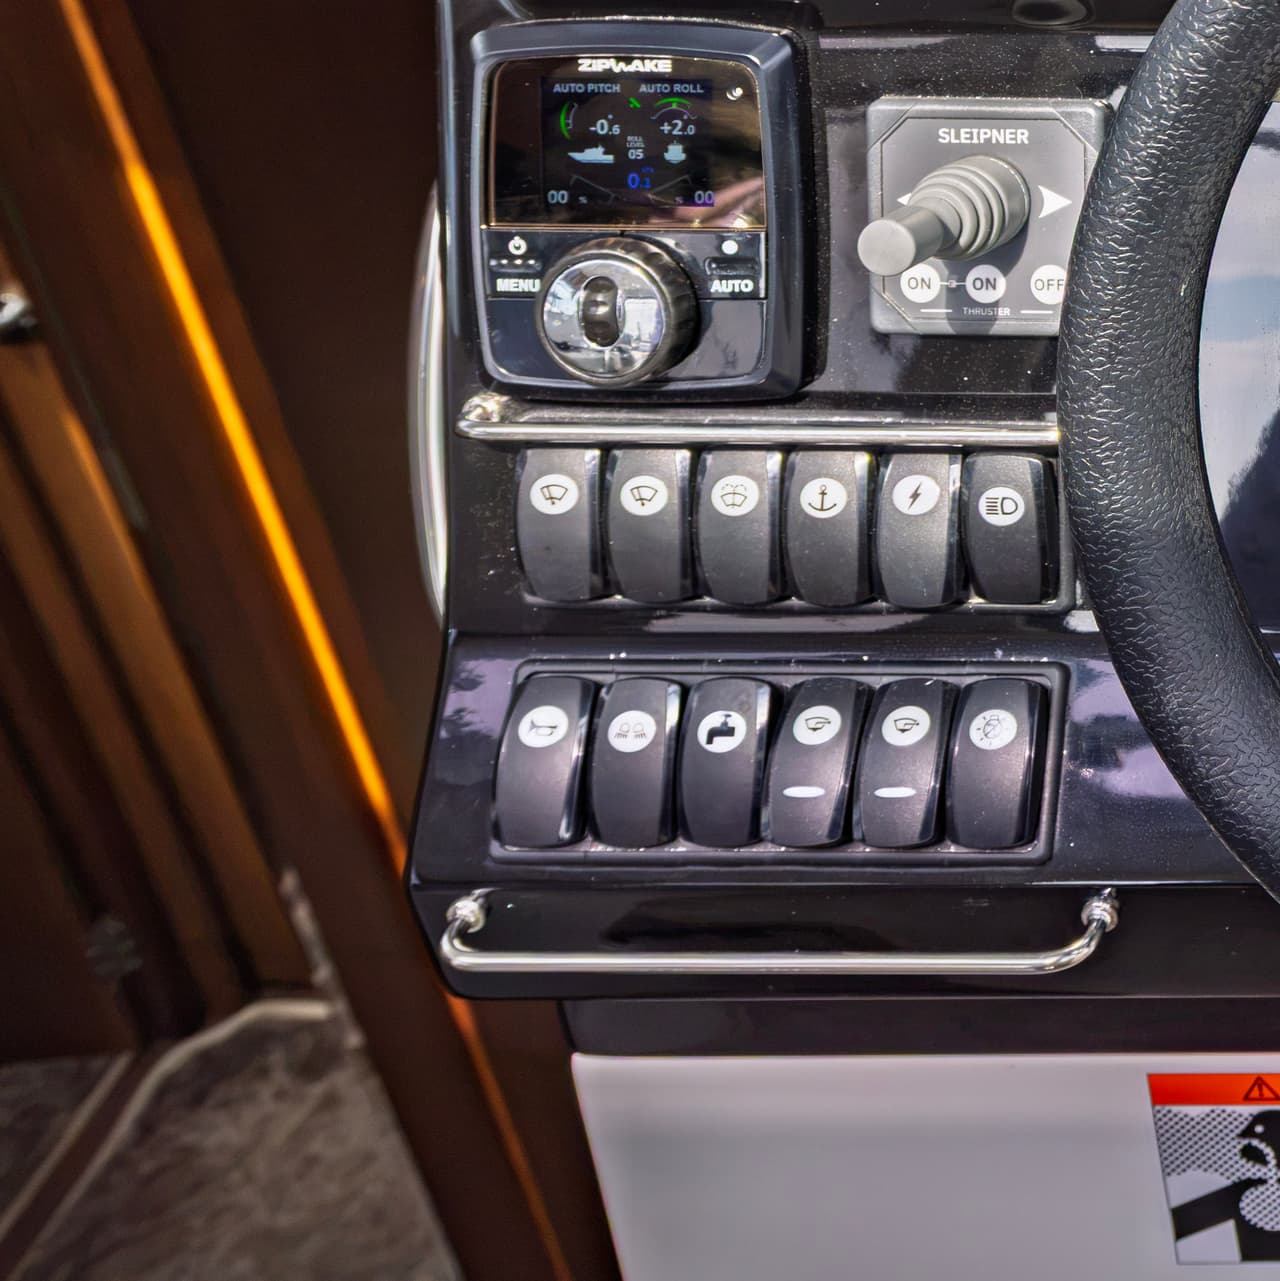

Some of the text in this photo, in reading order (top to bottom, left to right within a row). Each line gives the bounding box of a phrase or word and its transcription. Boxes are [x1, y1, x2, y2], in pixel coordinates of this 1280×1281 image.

[577, 58, 673, 73] ZIPWAKE
[553, 83, 621, 94] AUTO PITCH
[639, 83, 705, 94] AUTO ROLL
[937, 127, 1029, 145] SLEIPNER
[628, 149, 644, 160] 05
[627, 172, 652, 189] 0.1
[547, 190, 569, 204] 00
[694, 190, 715, 204] 00
[496, 278, 541, 293] MENU
[711, 278, 754, 293] AUTO
[907, 276, 1065, 292] ON ON OFF
[963, 306, 1011, 316] THRUSTER
